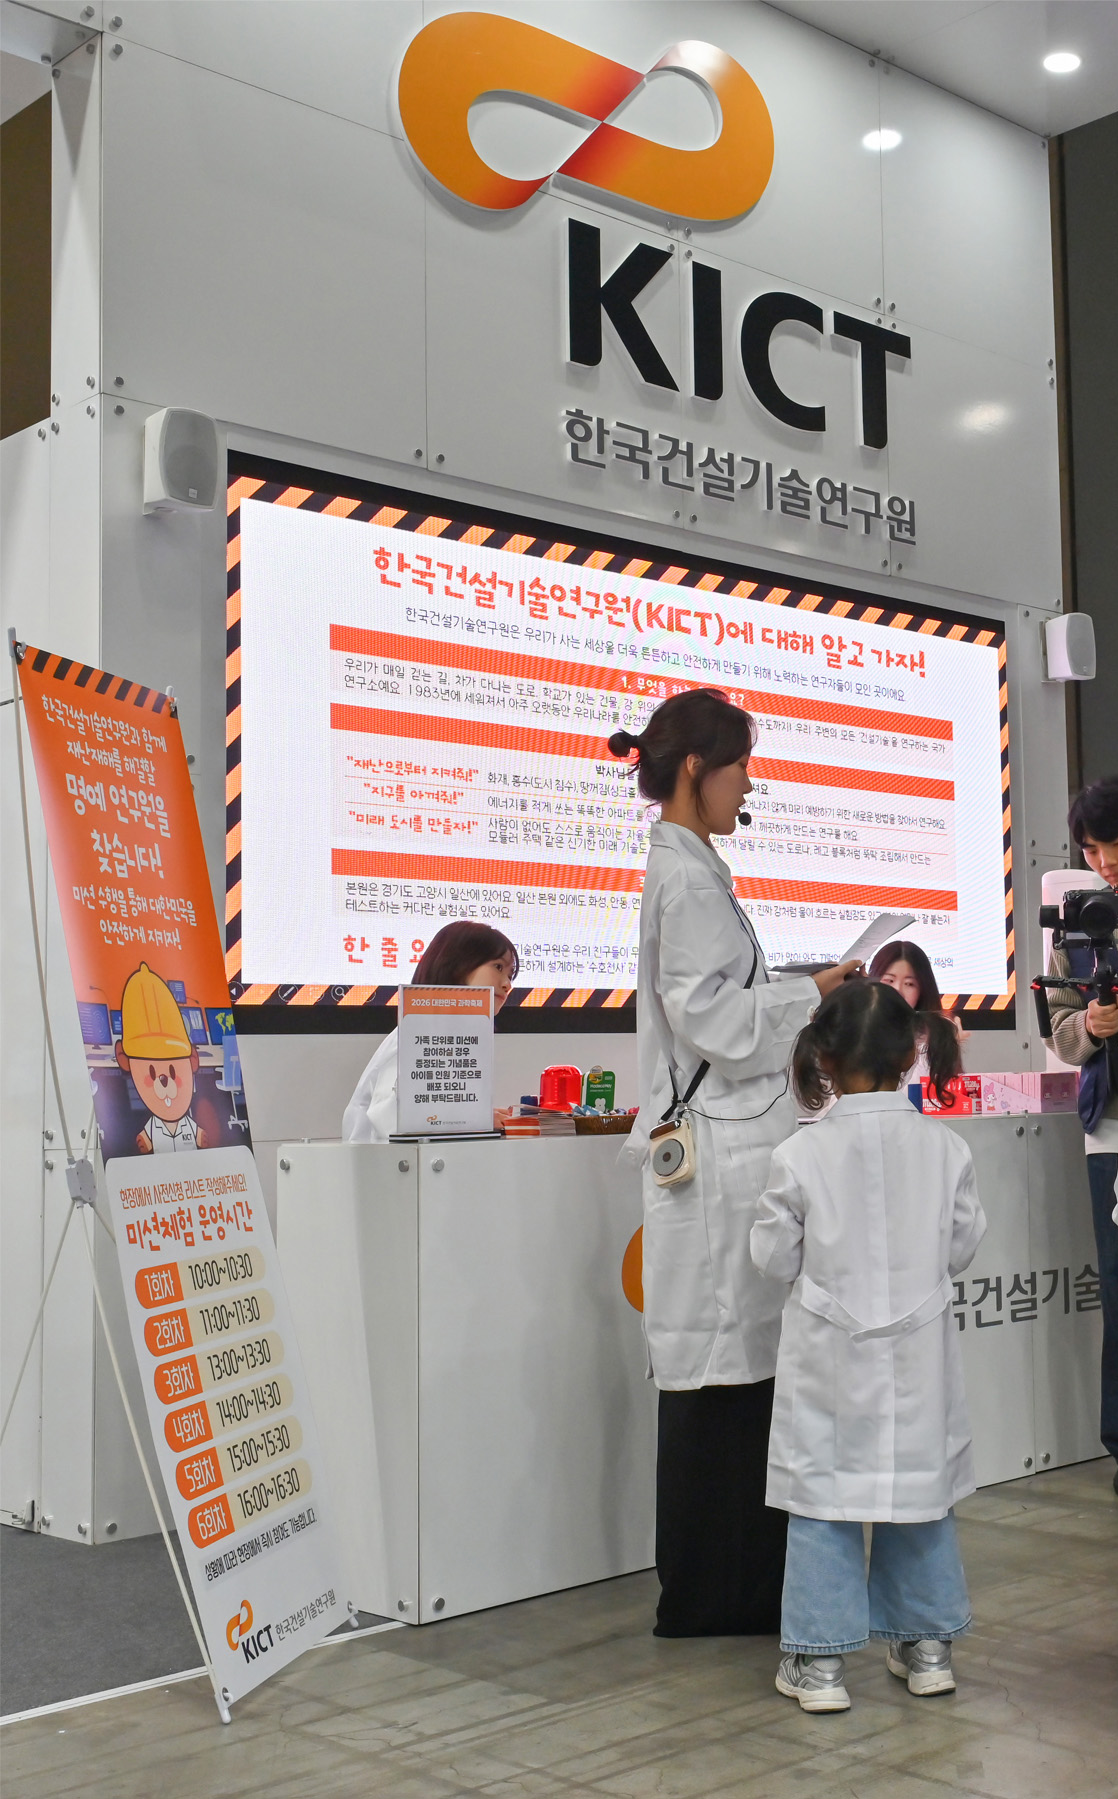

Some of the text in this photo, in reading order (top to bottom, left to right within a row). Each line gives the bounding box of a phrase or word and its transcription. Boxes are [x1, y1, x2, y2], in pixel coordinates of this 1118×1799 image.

[568, 217, 911, 450] KICT
[564, 407, 917, 546] 한국건설기술연구원
[373, 547, 925, 678] 한국건설기술연구원(KICT)에 대해 알고 가자!
[405, 606, 870, 696] 한국건설기술연구원은 우리가 사는 세상을 더욱 튼튼하고 안전하게 만들기 위해 노력하는 연구자들이 모인
[408, 683, 619, 724] 1983년에 세워져서 아주 오랫동안 우리나라를
[637, 678, 666, 697] 무엇을
[42, 694, 167, 753] 한국건설기술연구원과 함께
[67, 741, 155, 786] 재난재해를 해결할
[66, 773, 171, 838] 명예 연구원을
[91, 829, 164, 879] 찾습니다!
[73, 884, 197, 926] 미션 수행을 통해 대한민국을
[345, 898, 477, 918] 테스트하는 커다란 실험실도
[100, 919, 182, 950] 안전하게 지키자!
[343, 934, 398, 968] 한 줄
[411, 998, 430, 1007] 2026
[415, 1036, 479, 1045] 가족 단위로 미션에
[416, 1059, 477, 1068] 증정되는 기념품은
[423, 1047, 470, 1057] 참여하실 경우
[411, 1070, 482, 1080] 아이들 인원 기준으로
[414, 1093, 478, 1103] 양해 부탁드립니다.
[427, 1082, 466, 1091] 배포 되오니
[120, 1173, 248, 1210] 현장에서 사전신청 리스트 작성해주세요!
[126, 1201, 254, 1251] 미션체험 운영시간
[144, 1253, 253, 1301] 1회차 10:00~10:30
[952, 1263, 1101, 1332] 국건설기술
[153, 1296, 260, 1350] 2회차 11:00~11:30
[163, 1338, 271, 1397] 3회차 13:00~13:30
[173, 1381, 281, 1443] 4회차 14:00~14:30
[184, 1424, 290, 1493] 5회차 15:00~15:30
[196, 1467, 301, 1540] 6회차 16:00~16:30
[204, 1507, 317, 1582] 상황에 따라 현장에서 즉시 참여도 가능합니다.
[241, 1588, 336, 1664] KICT 한국건설기술연구원
